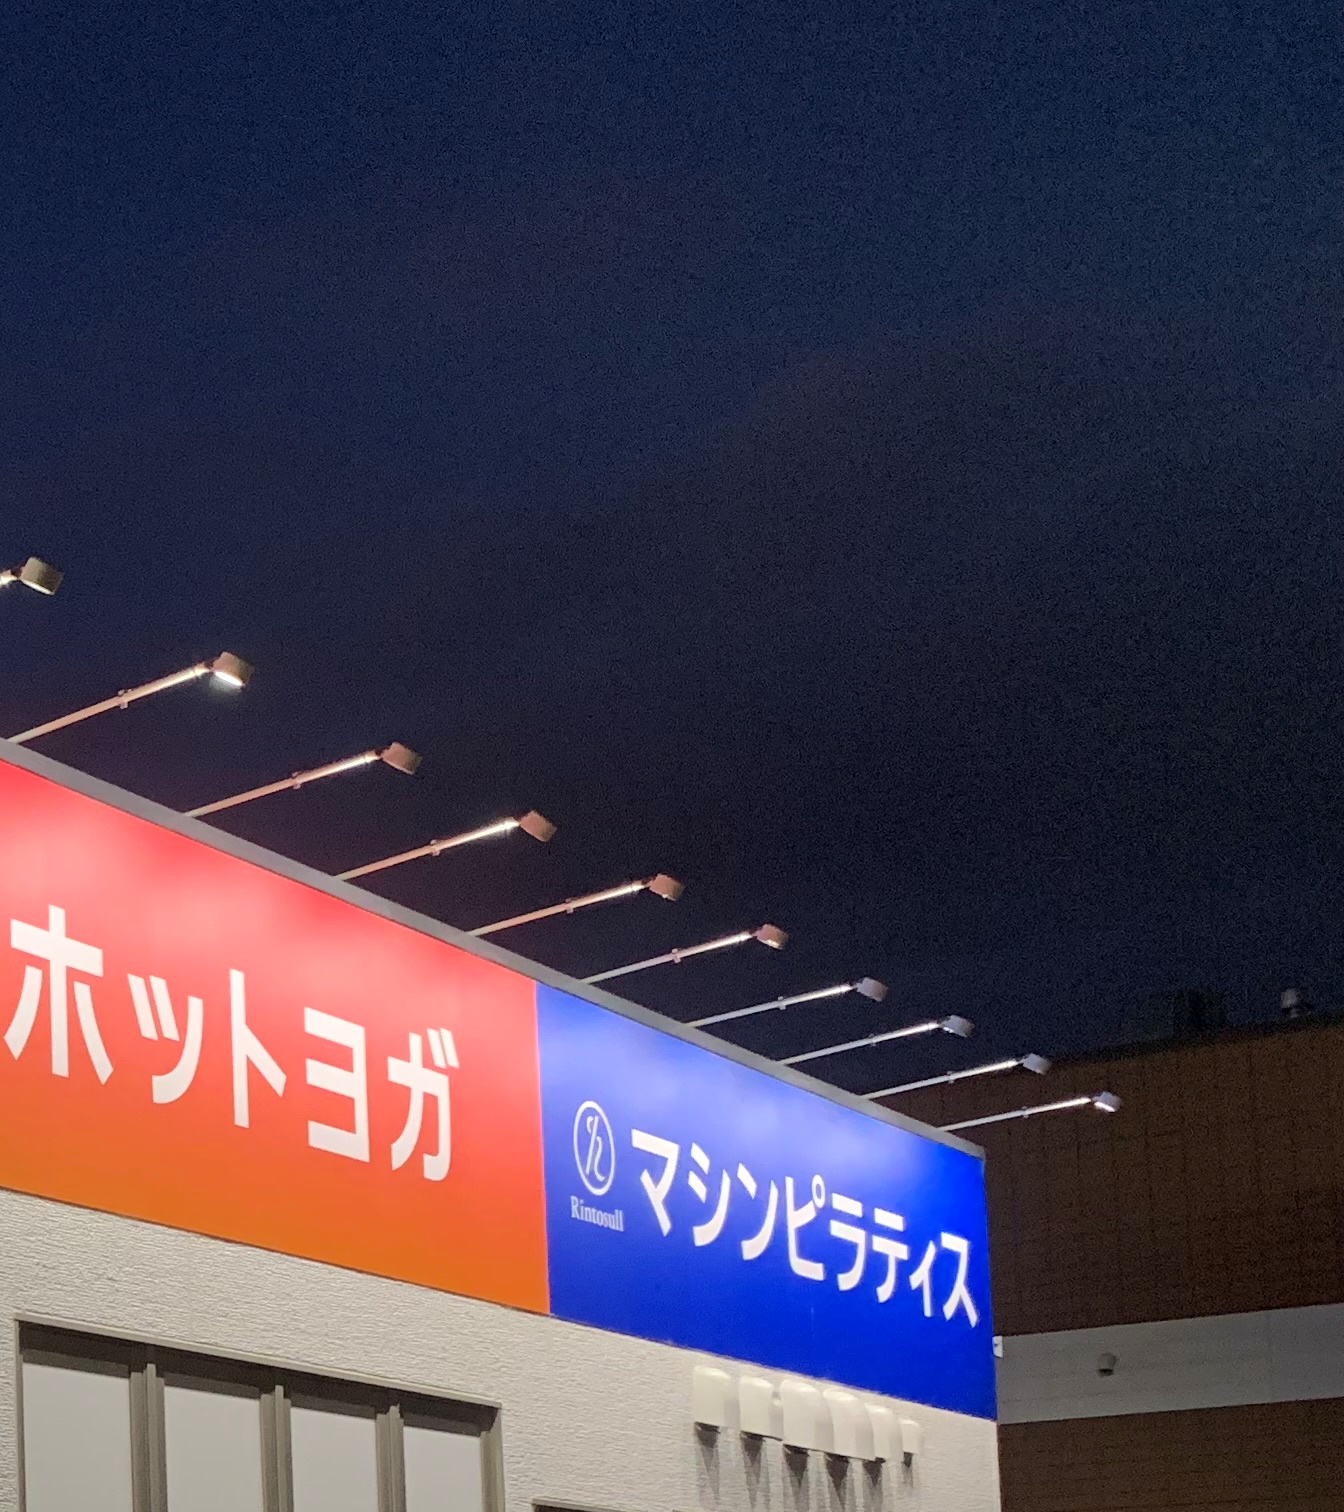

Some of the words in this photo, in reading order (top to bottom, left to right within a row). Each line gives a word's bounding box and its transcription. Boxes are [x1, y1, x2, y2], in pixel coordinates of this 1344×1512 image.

[4, 905, 459, 1182] ホットヨガ
[570, 1195, 624, 1232] Rintosull
[631, 1129, 980, 1328] マシンピラティス
